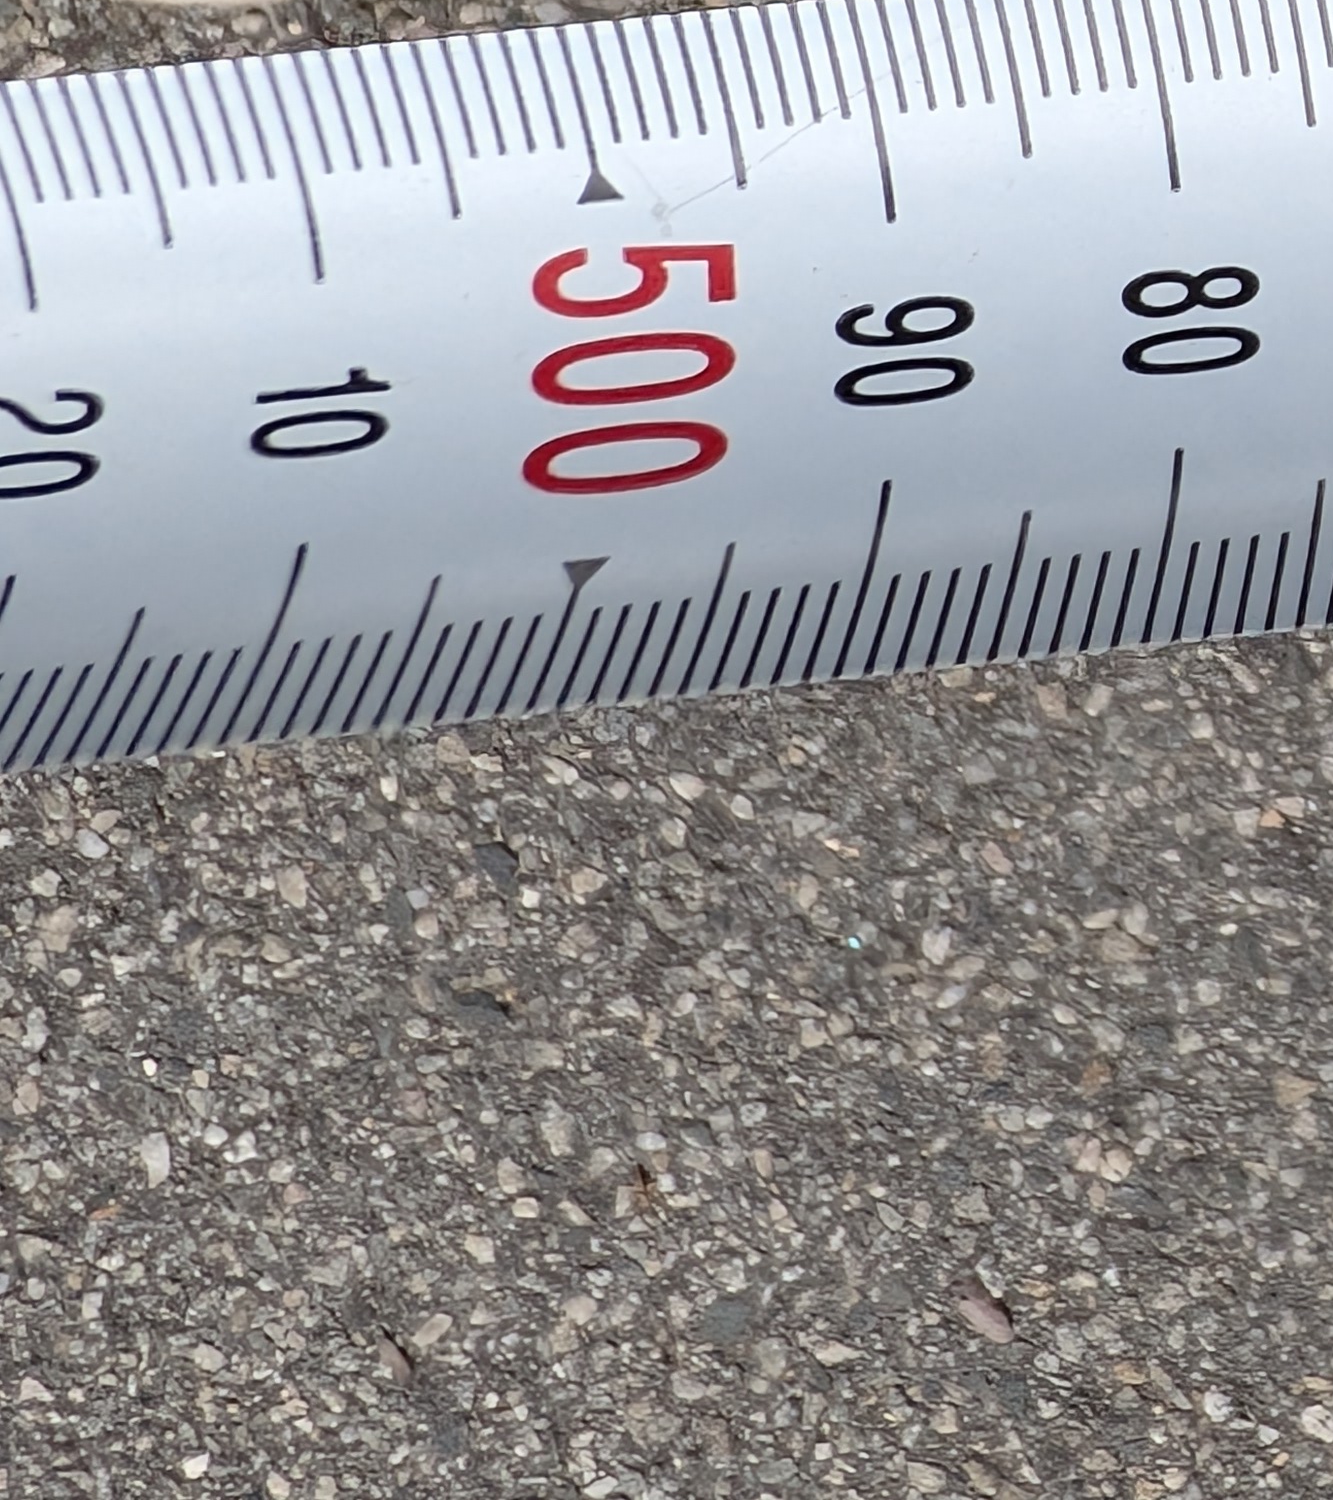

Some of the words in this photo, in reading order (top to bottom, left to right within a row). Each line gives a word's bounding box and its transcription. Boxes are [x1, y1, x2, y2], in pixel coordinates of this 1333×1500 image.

[520, 243, 737, 496] 500
[833, 295, 976, 408] 90
[1121, 265, 1262, 377] 80
[0, 389, 105, 500] 20
[249, 367, 393, 460] 10
